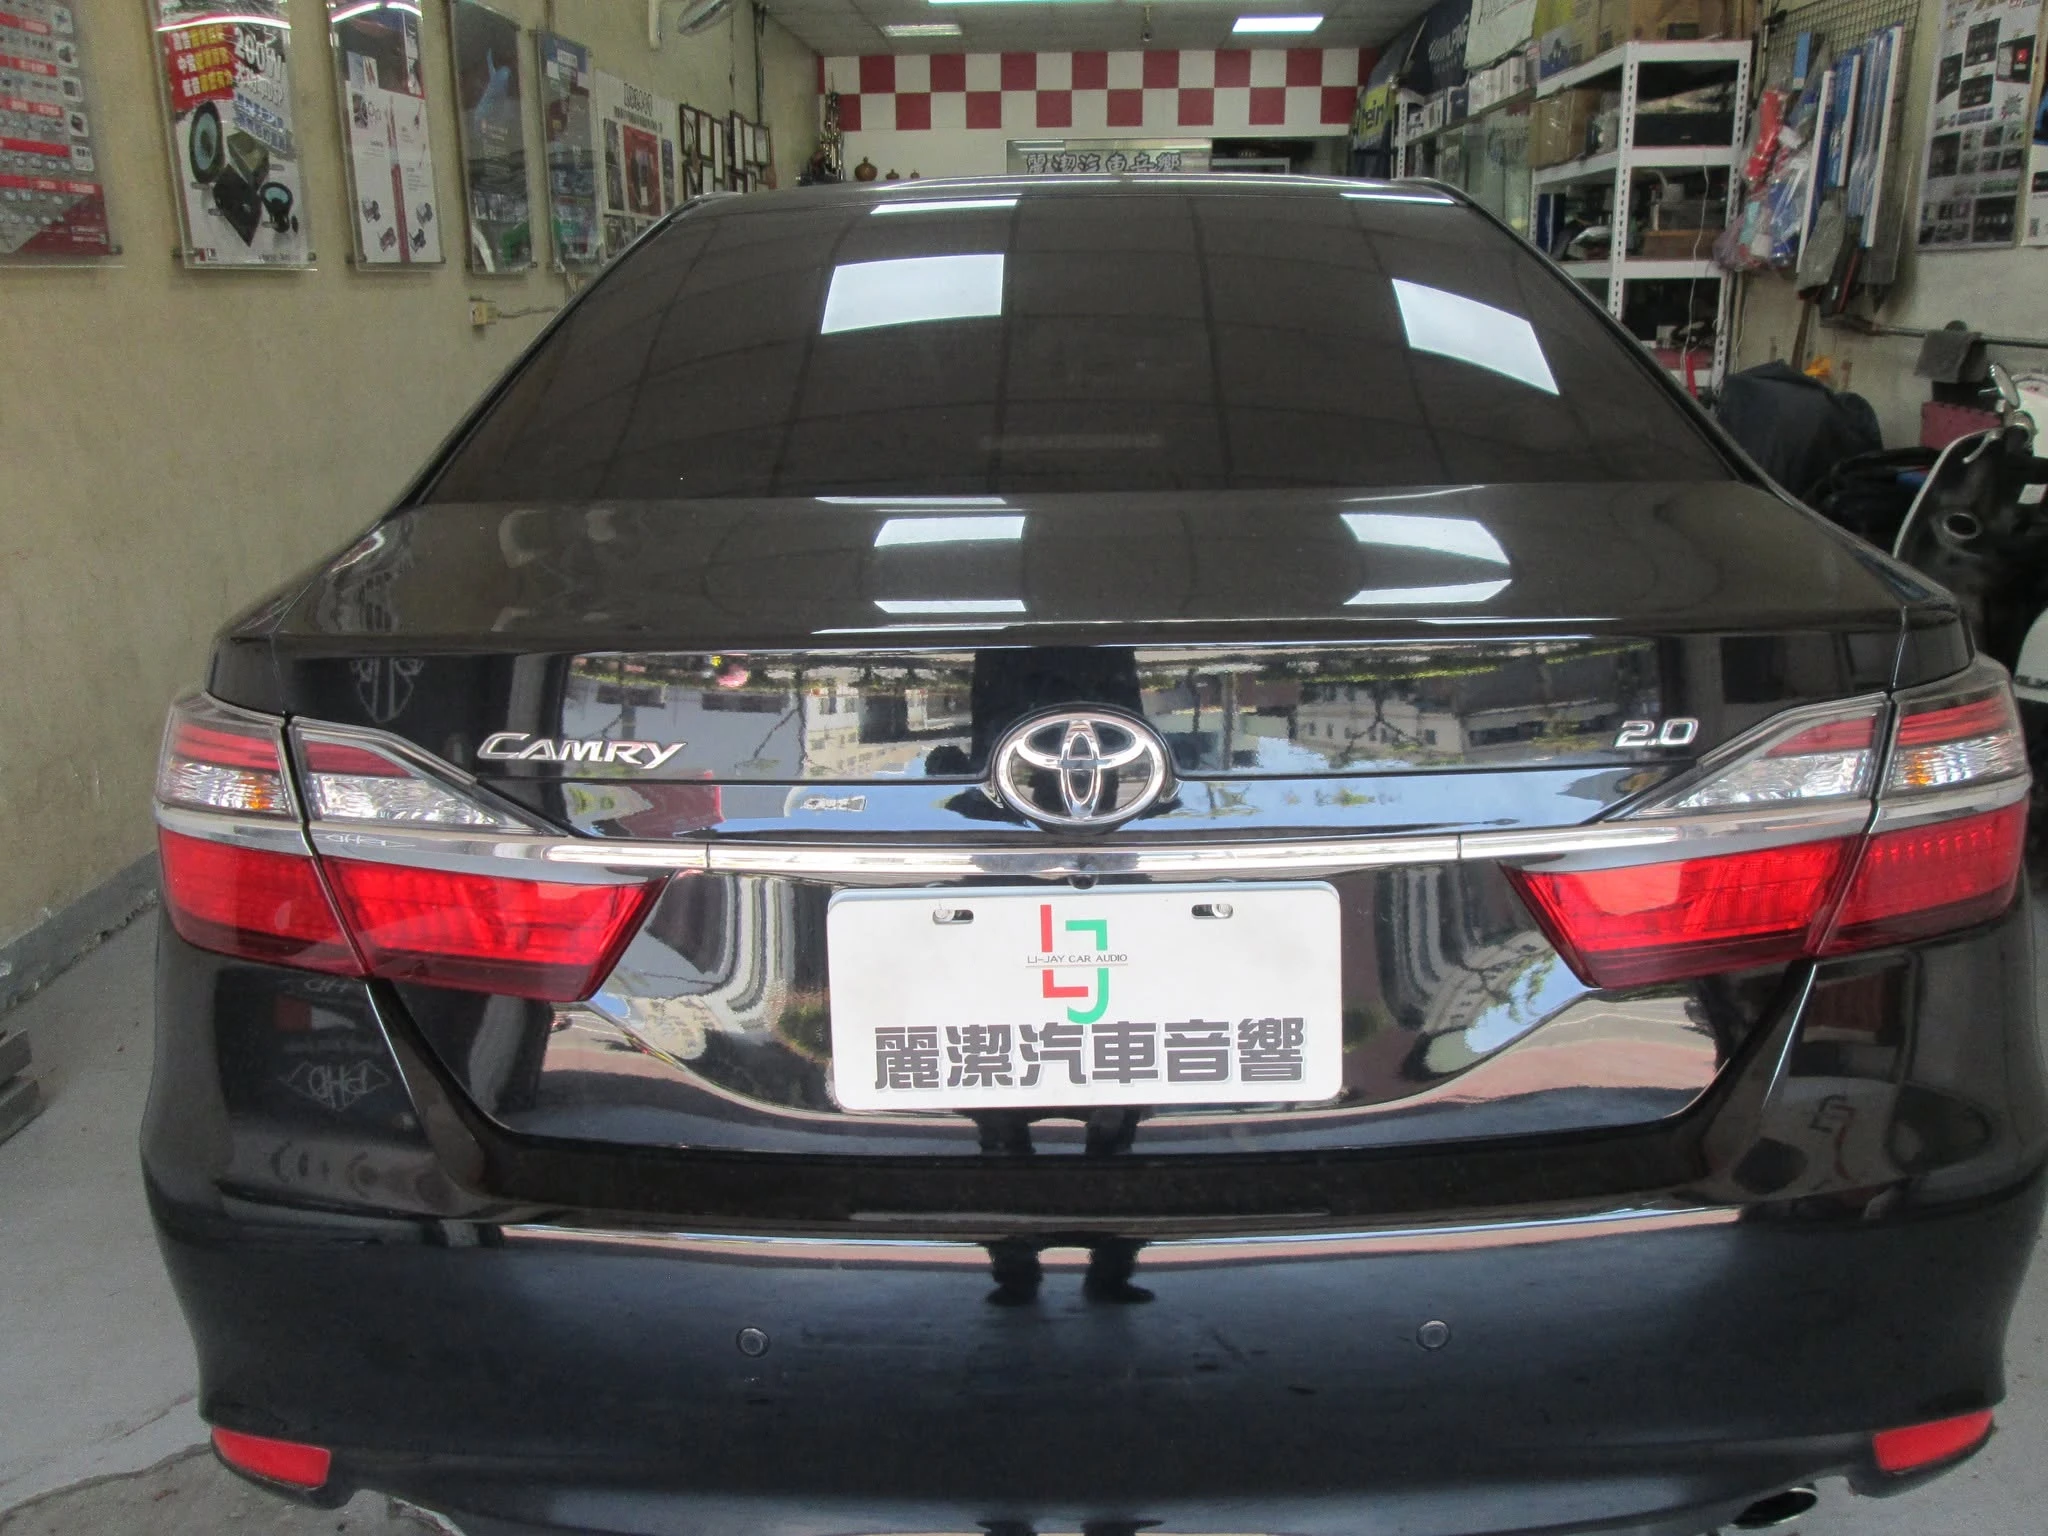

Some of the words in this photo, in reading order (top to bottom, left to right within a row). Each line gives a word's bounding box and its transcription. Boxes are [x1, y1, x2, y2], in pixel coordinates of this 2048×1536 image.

[1615, 717, 1699, 747] 2.0
[477, 732, 687, 770] CAMRY
[1027, 955, 1065, 964] LI-JAY
[1068, 955, 1092, 963] CAR
[1095, 953, 1128, 963] AUDIO
[873, 1017, 1304, 1090] 麗潔汽車音響
